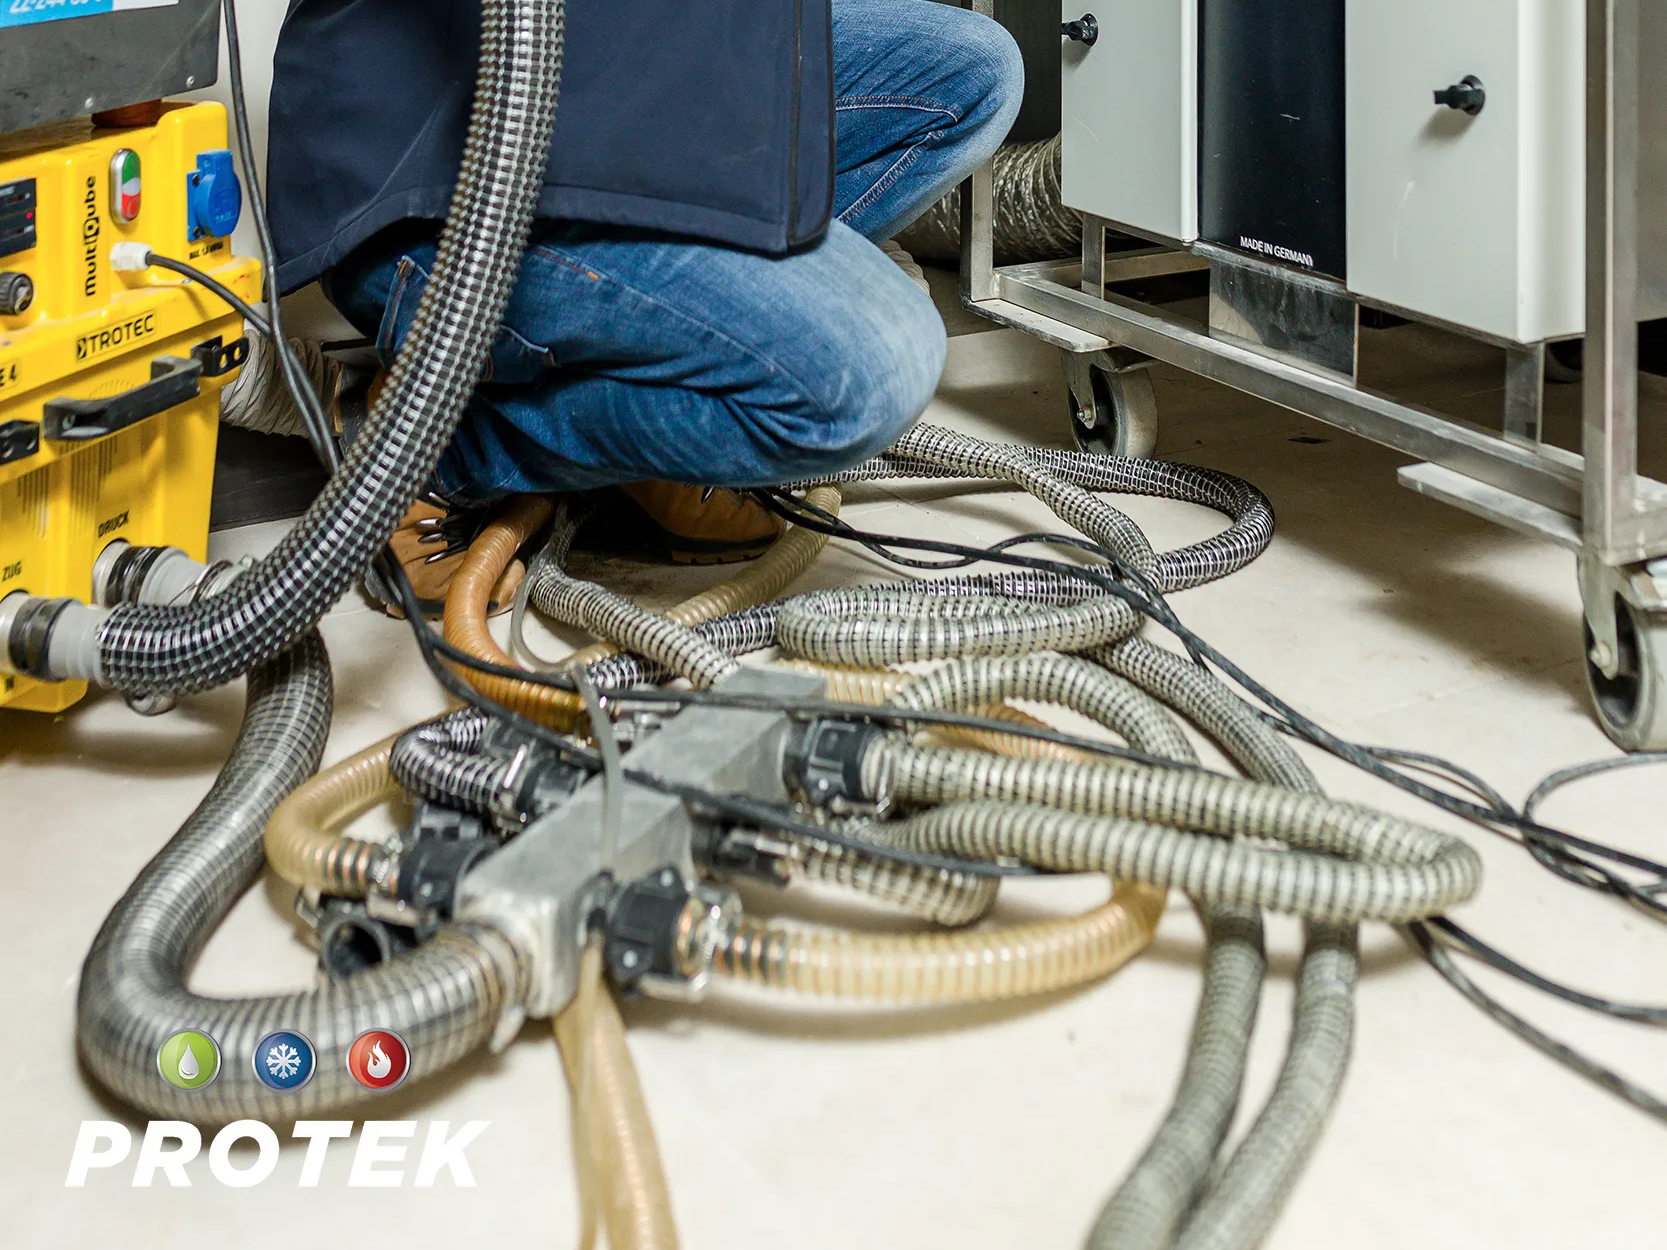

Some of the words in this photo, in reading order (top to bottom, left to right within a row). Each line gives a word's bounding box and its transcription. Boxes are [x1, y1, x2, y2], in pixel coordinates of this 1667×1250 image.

[1240, 236, 1263, 252] MADE
[1274, 245, 1313, 266] GERMANY
[89, 313, 155, 353] TROTEC
[97, 510, 129, 538] DRUCK
[2, 560, 22, 582] ZUG
